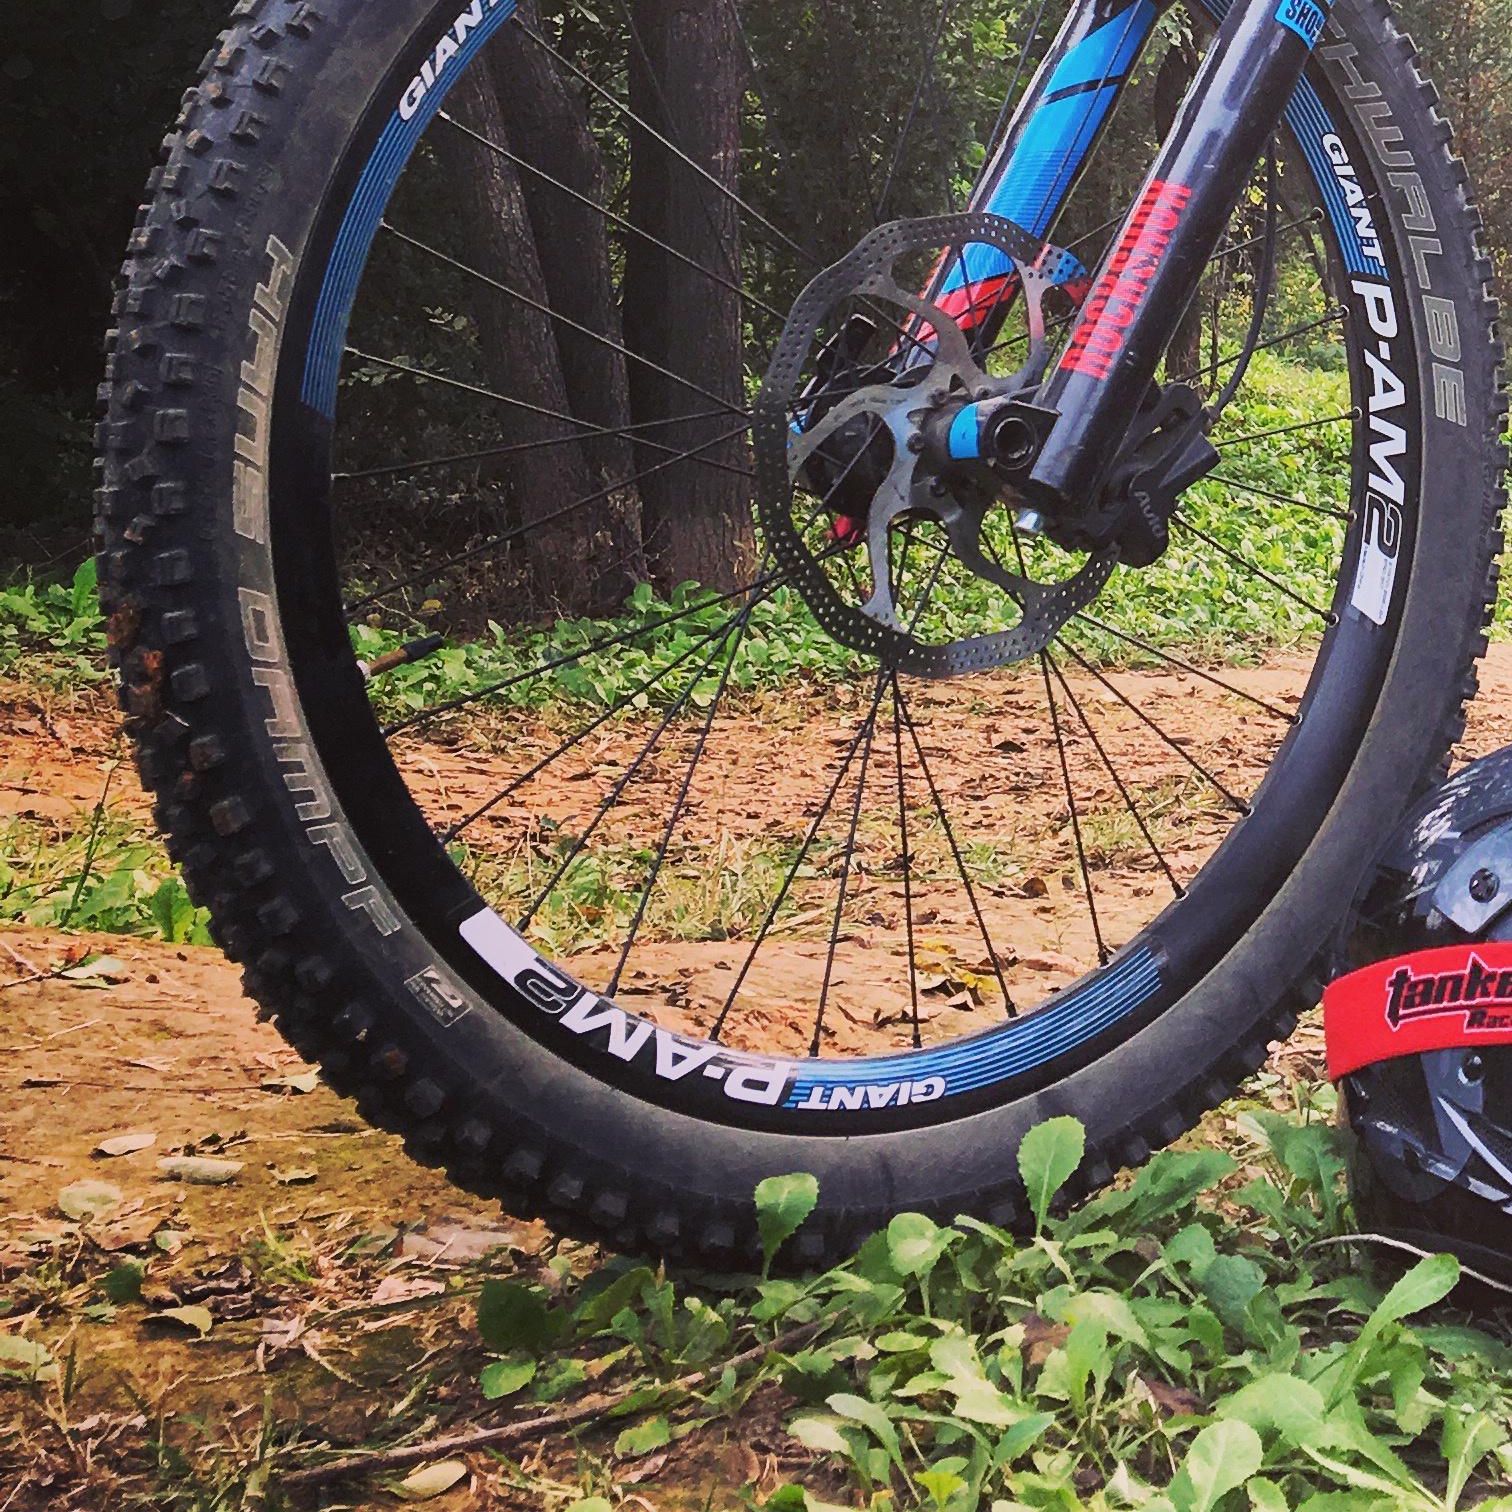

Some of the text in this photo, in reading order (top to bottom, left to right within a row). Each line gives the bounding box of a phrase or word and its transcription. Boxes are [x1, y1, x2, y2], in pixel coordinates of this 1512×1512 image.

[1321, 132, 1388, 269] GIANT
[1350, 278, 1406, 561] P-AM2
[798, 1075, 948, 1111] GIANT
